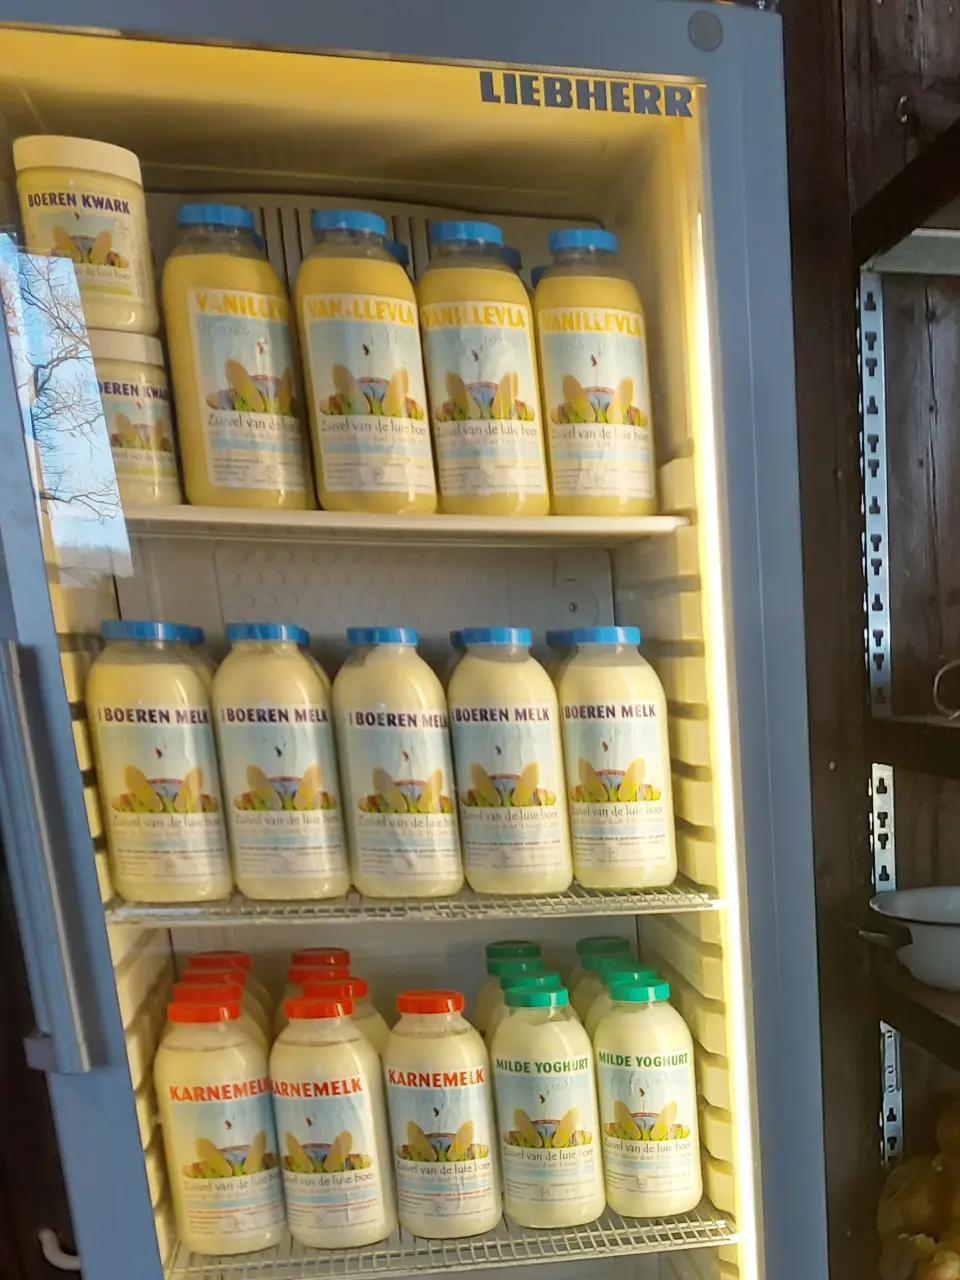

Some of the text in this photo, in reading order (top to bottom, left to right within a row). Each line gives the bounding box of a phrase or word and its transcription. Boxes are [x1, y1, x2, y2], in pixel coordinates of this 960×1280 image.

[479, 71, 693, 117] LIEBHERR
[28, 192, 130, 215] BOEREN KWARK
[307, 298, 414, 325] VANILLEVLA
[422, 305, 525, 329] VANILLEVLA
[541, 312, 641, 336] VANILLEVLA
[97, 382, 139, 397] OEREN
[208, 413, 242, 428] Zuivel
[246, 419, 265, 429] van
[321, 417, 349, 432] Zuivel
[352, 421, 371, 431] van
[375, 420, 389, 432] de
[463, 425, 482, 436] van
[485, 423, 498, 437] de
[578, 428, 596, 441] van
[598, 425, 612, 441] de
[104, 707, 209, 724] BOEREN MELK
[226, 707, 328, 723] BOEREN MELK
[355, 711, 417, 728] BOEREN
[455, 707, 549, 723] BOEREN MELK
[565, 703, 656, 720] BOEREN MELK
[485, 812, 502, 822] van
[504, 810, 518, 822] de
[592, 806, 609, 816] van
[611, 805, 624, 817] de
[145, 818, 164, 828] van
[169, 815, 183, 829] de
[265, 815, 284, 825] van
[496, 1057, 588, 1074] MILDE YOGHURT
[599, 1051, 688, 1067] MILDE YOGHURT
[389, 1067, 485, 1088] KARNEMELK
[272, 1078, 363, 1097] ARNEMELK
[625, 1142, 641, 1153] van
[643, 1140, 655, 1153] de
[656, 1139, 673, 1152] luie
[675, 1140, 691, 1151] boer
[527, 1151, 543, 1161] van
[545, 1149, 557, 1161] de
[559, 1148, 576, 1160] luie
[420, 1165, 437, 1175] van
[440, 1163, 452, 1175] de
[454, 1162, 472, 1174] luie
[215, 1181, 234, 1192] van
[237, 1178, 249, 1189] de
[319, 1176, 330, 1187] de
[355, 1171, 375, 1183] boer
